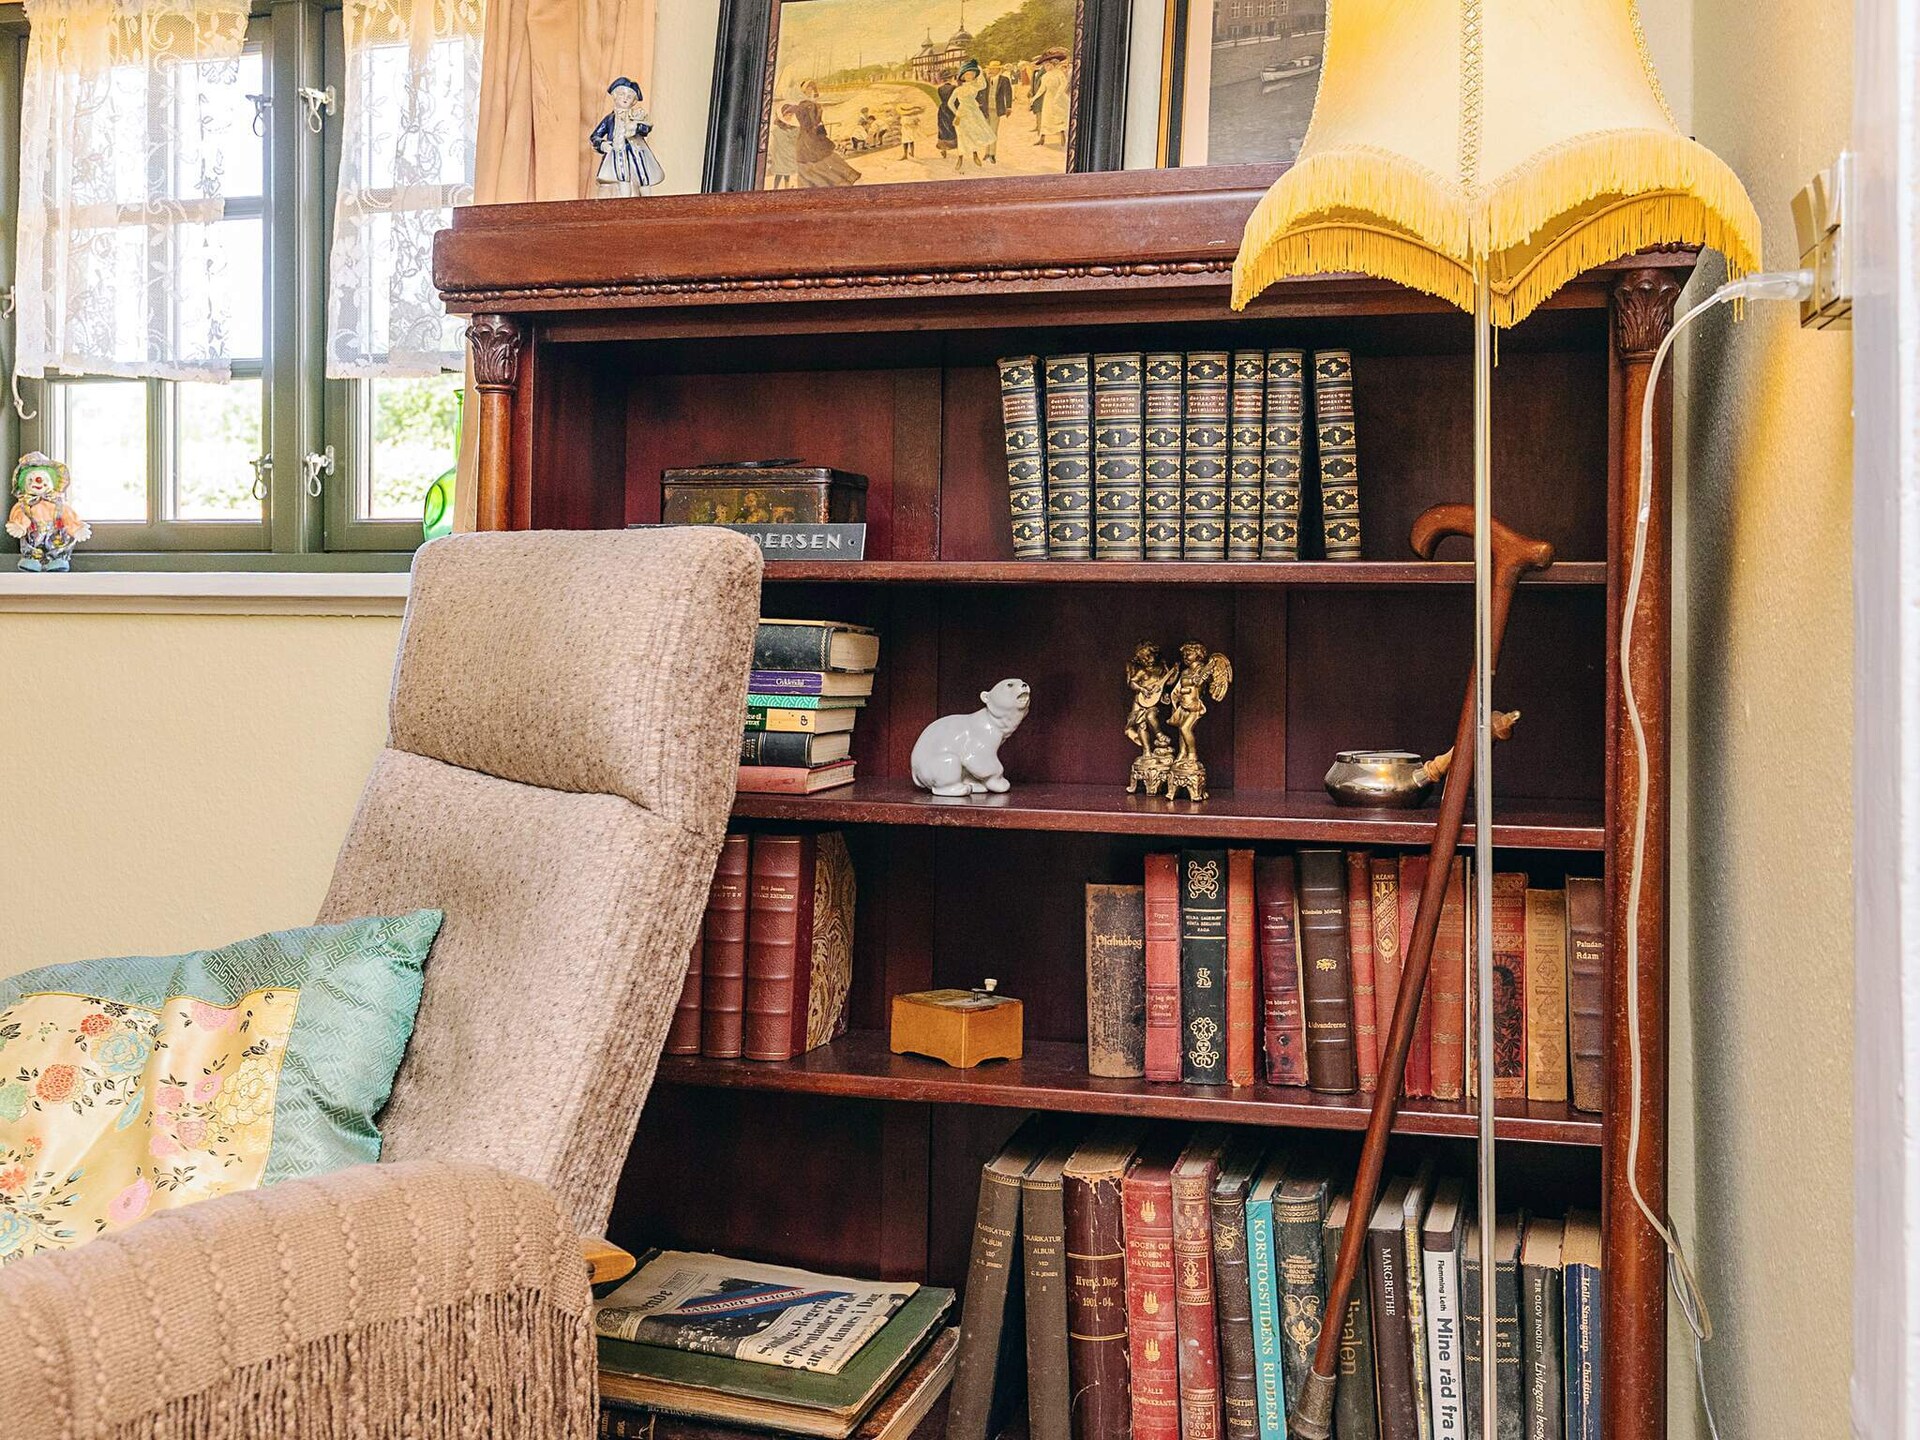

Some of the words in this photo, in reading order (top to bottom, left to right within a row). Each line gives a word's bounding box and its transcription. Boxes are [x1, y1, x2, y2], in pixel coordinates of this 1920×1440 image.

[750, 532, 840, 551] DERSEN
[981, 1238, 1003, 1248] ALBUM
[1024, 1234, 1062, 1242] KARIKATUR
[1254, 1218, 1274, 1356] KORSTOGSTIDENS
[1382, 1248, 1396, 1316] MARGRETHE
[1437, 1260, 1446, 1294] Flemming
[680, 1300, 748, 1314] DANMARK
[1437, 1318, 1453, 1362] Mine
[1535, 1316, 1543, 1354] ENQUIST
[1580, 1304, 1590, 1352] Stangerup
[1263, 1362, 1279, 1431] RIDDERE
[1440, 1369, 1457, 1398] råd
[1532, 1362, 1547, 1414] Livlægens
[1583, 1362, 1592, 1406] Christine
[1441, 1405, 1458, 1430] fra
